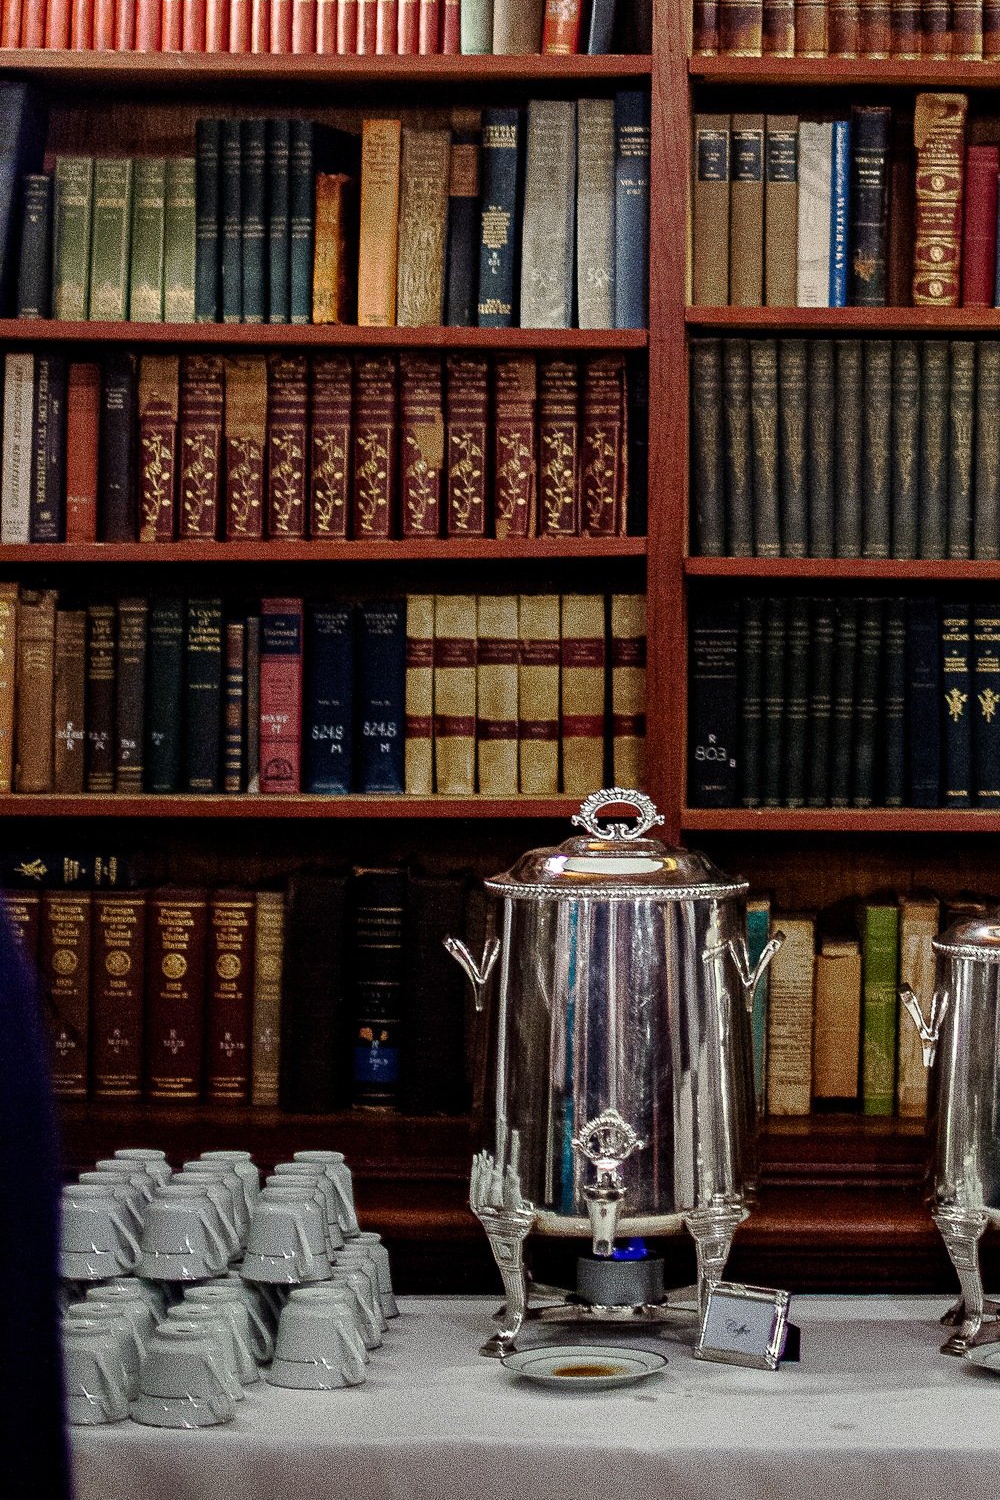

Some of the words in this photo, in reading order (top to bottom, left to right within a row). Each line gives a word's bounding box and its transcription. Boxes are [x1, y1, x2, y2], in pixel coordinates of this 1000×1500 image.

[38, 360, 49, 424] PRELUDE
[36, 448, 47, 504] TERROR
[942, 633, 969, 642] NATIONS
[694, 744, 728, 762] 803
